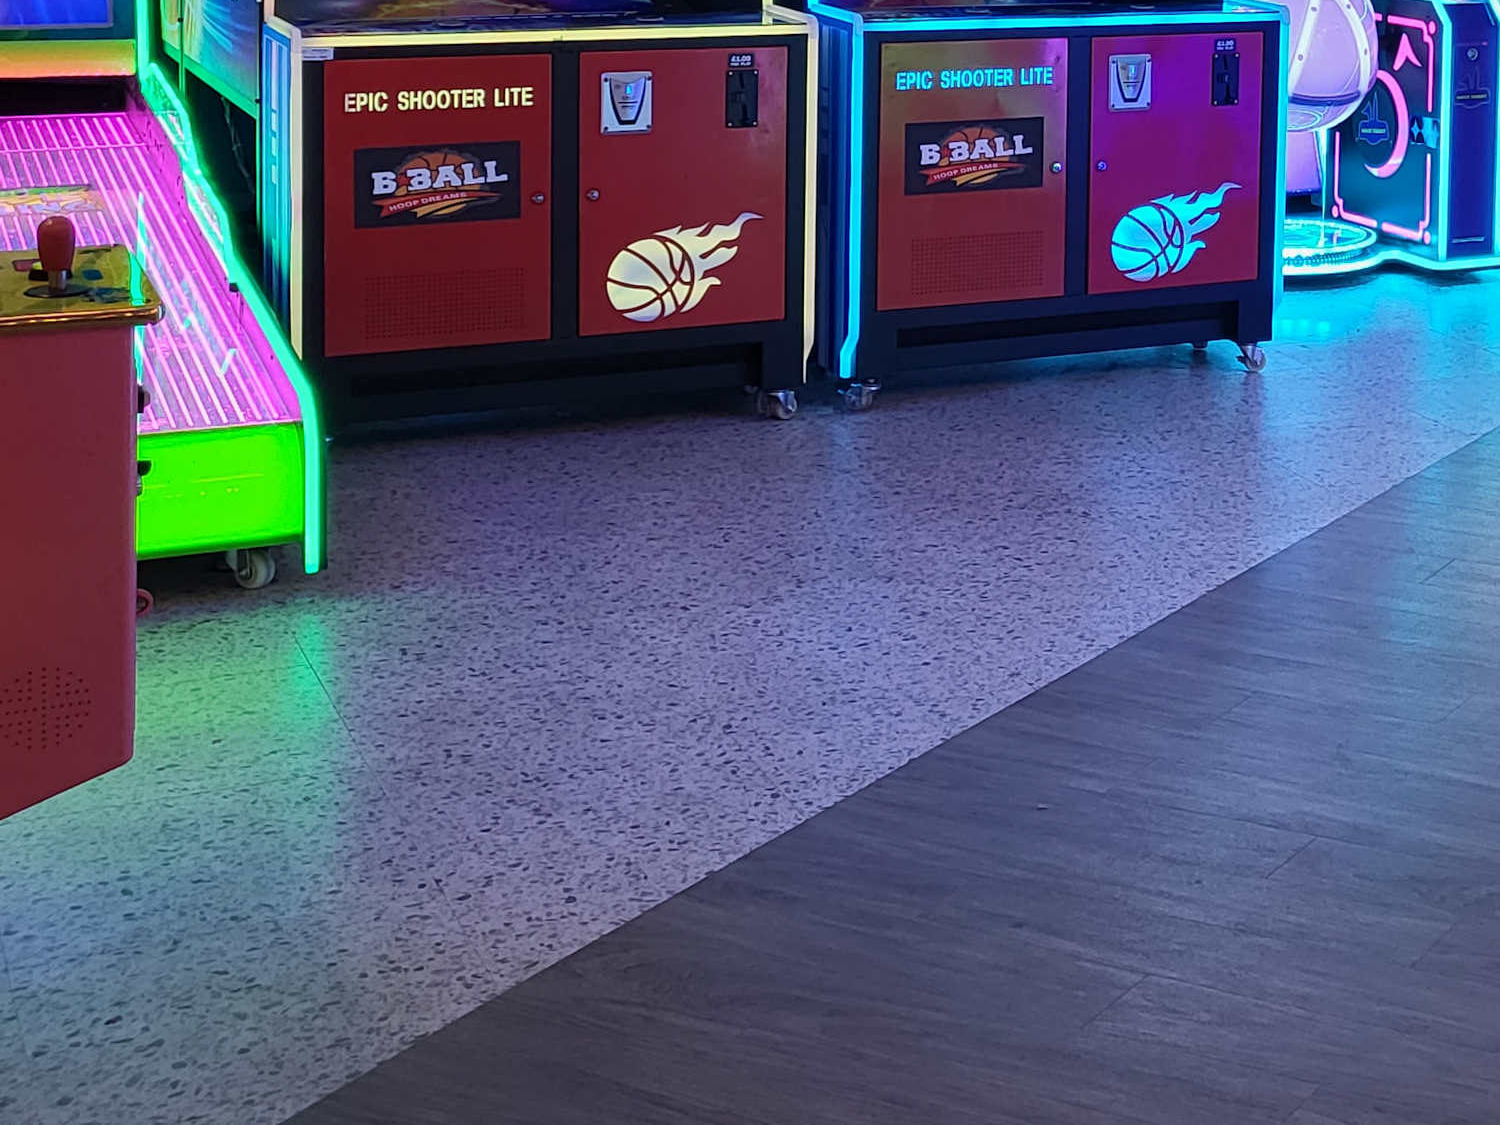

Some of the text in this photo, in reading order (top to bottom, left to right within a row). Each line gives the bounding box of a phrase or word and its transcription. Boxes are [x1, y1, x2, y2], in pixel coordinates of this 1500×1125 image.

[896, 66, 1054, 91] EPIC SHOOTER LITE
[344, 86, 536, 113] EPIC SHOOTER LITE
[933, 169, 959, 180] HOOP
[388, 197, 421, 212] HOOP
